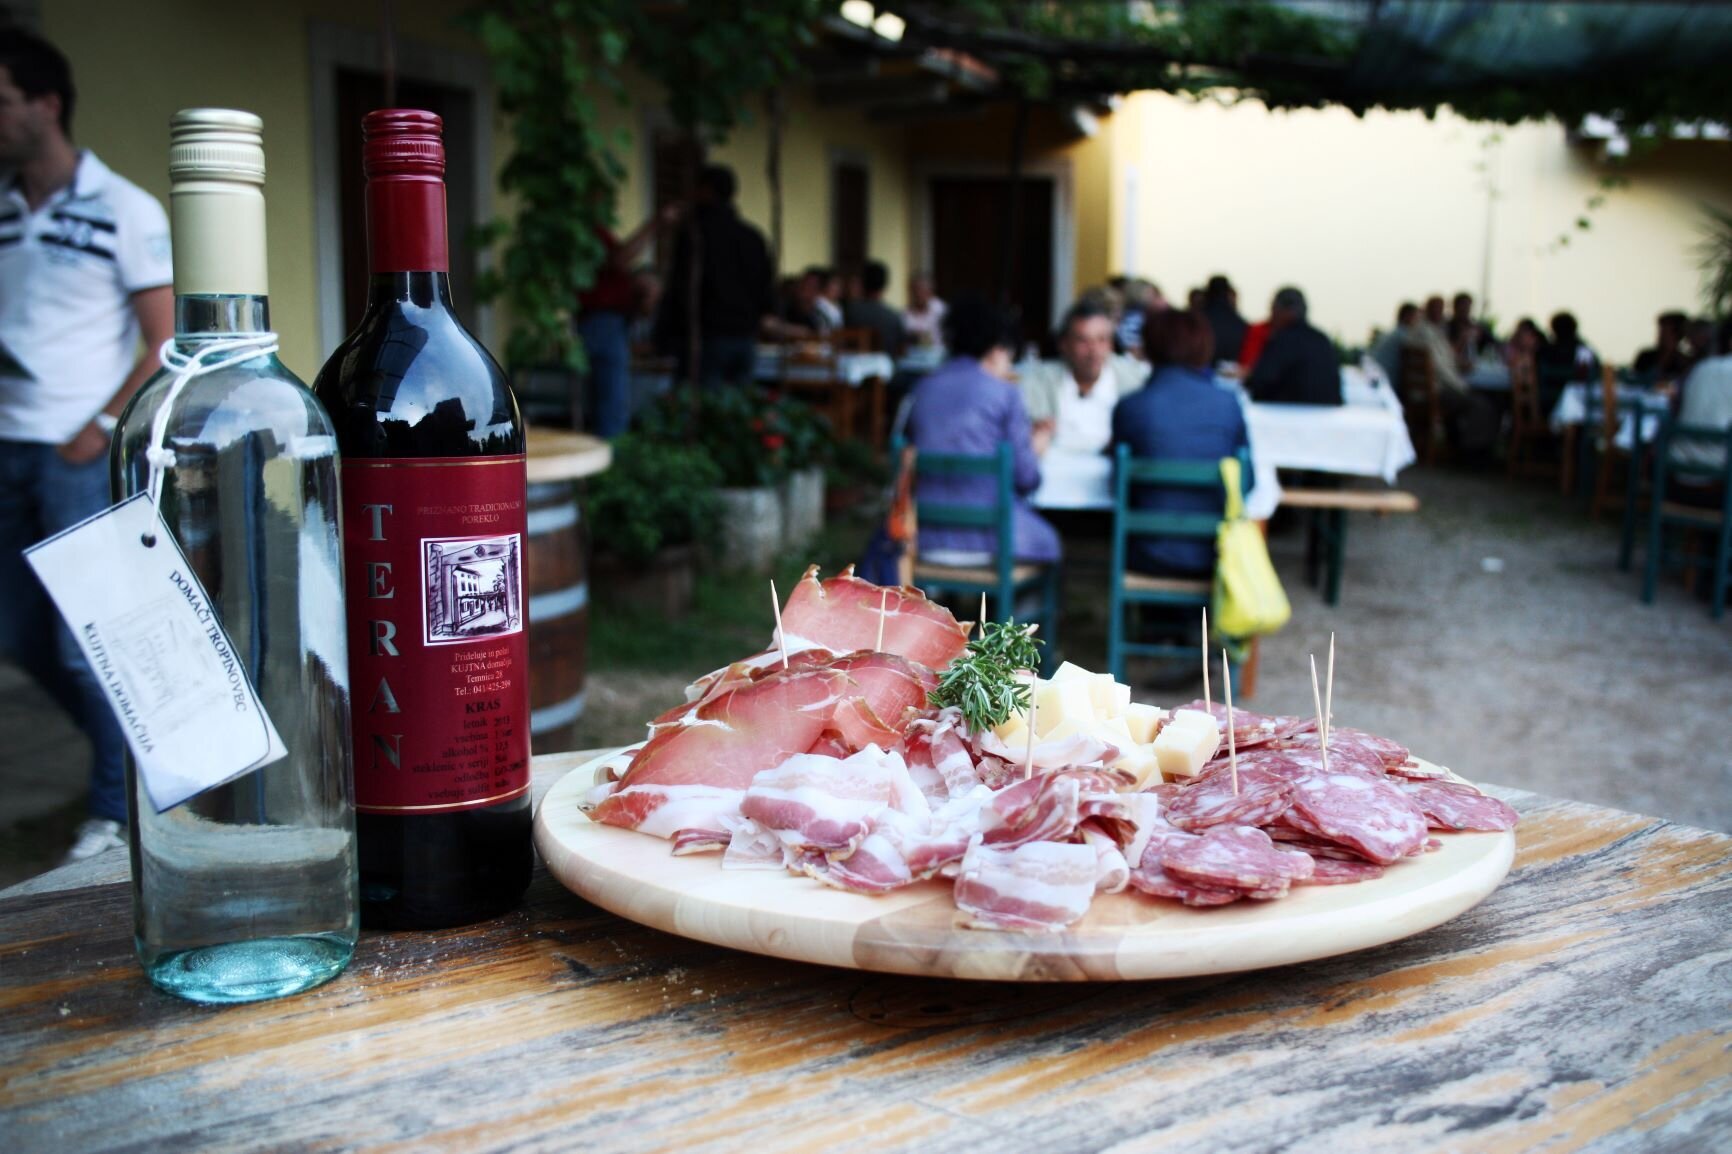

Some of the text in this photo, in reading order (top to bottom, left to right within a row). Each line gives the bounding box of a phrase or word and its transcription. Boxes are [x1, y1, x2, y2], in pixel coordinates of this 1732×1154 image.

[462, 514, 500, 524] POREKLO
[168, 569, 247, 712] DOMAČI TROPINOVEC
[361, 503, 404, 771] TERAN
[455, 650, 487, 661] Prideluje
[451, 662, 486, 673] KUJTNA
[466, 672, 494, 683] Temnica
[83, 621, 157, 754] KUJTNA DOMAČIJA
[465, 700, 500, 714] KRAS
[442, 746, 477, 758] alkohol
